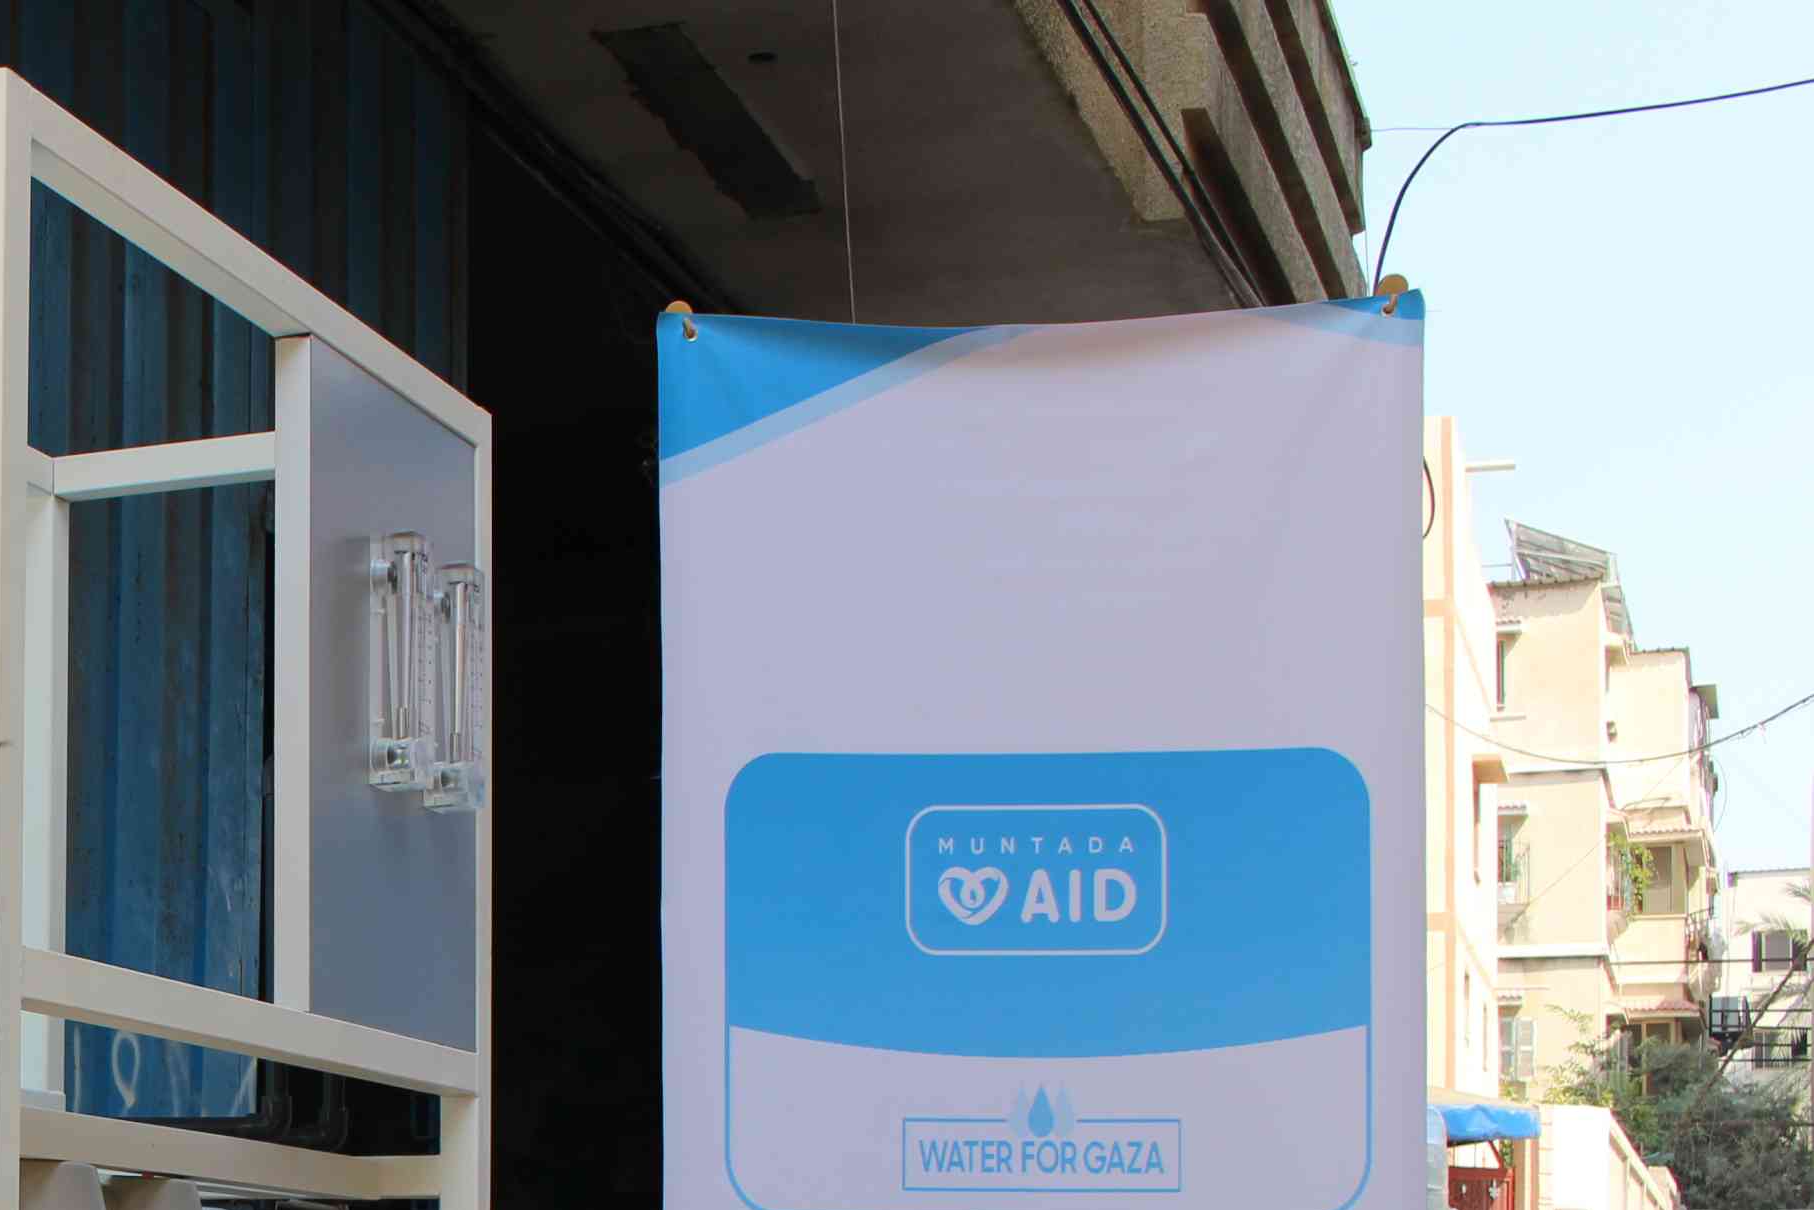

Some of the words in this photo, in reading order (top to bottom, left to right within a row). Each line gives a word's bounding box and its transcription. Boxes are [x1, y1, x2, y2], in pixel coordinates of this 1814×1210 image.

[937, 836, 1134, 855] MUNTADA
[1020, 867, 1137, 924] AID
[918, 1139, 1014, 1174] WATER
[1020, 1139, 1077, 1174] FOR
[1083, 1140, 1165, 1175] GAZA
